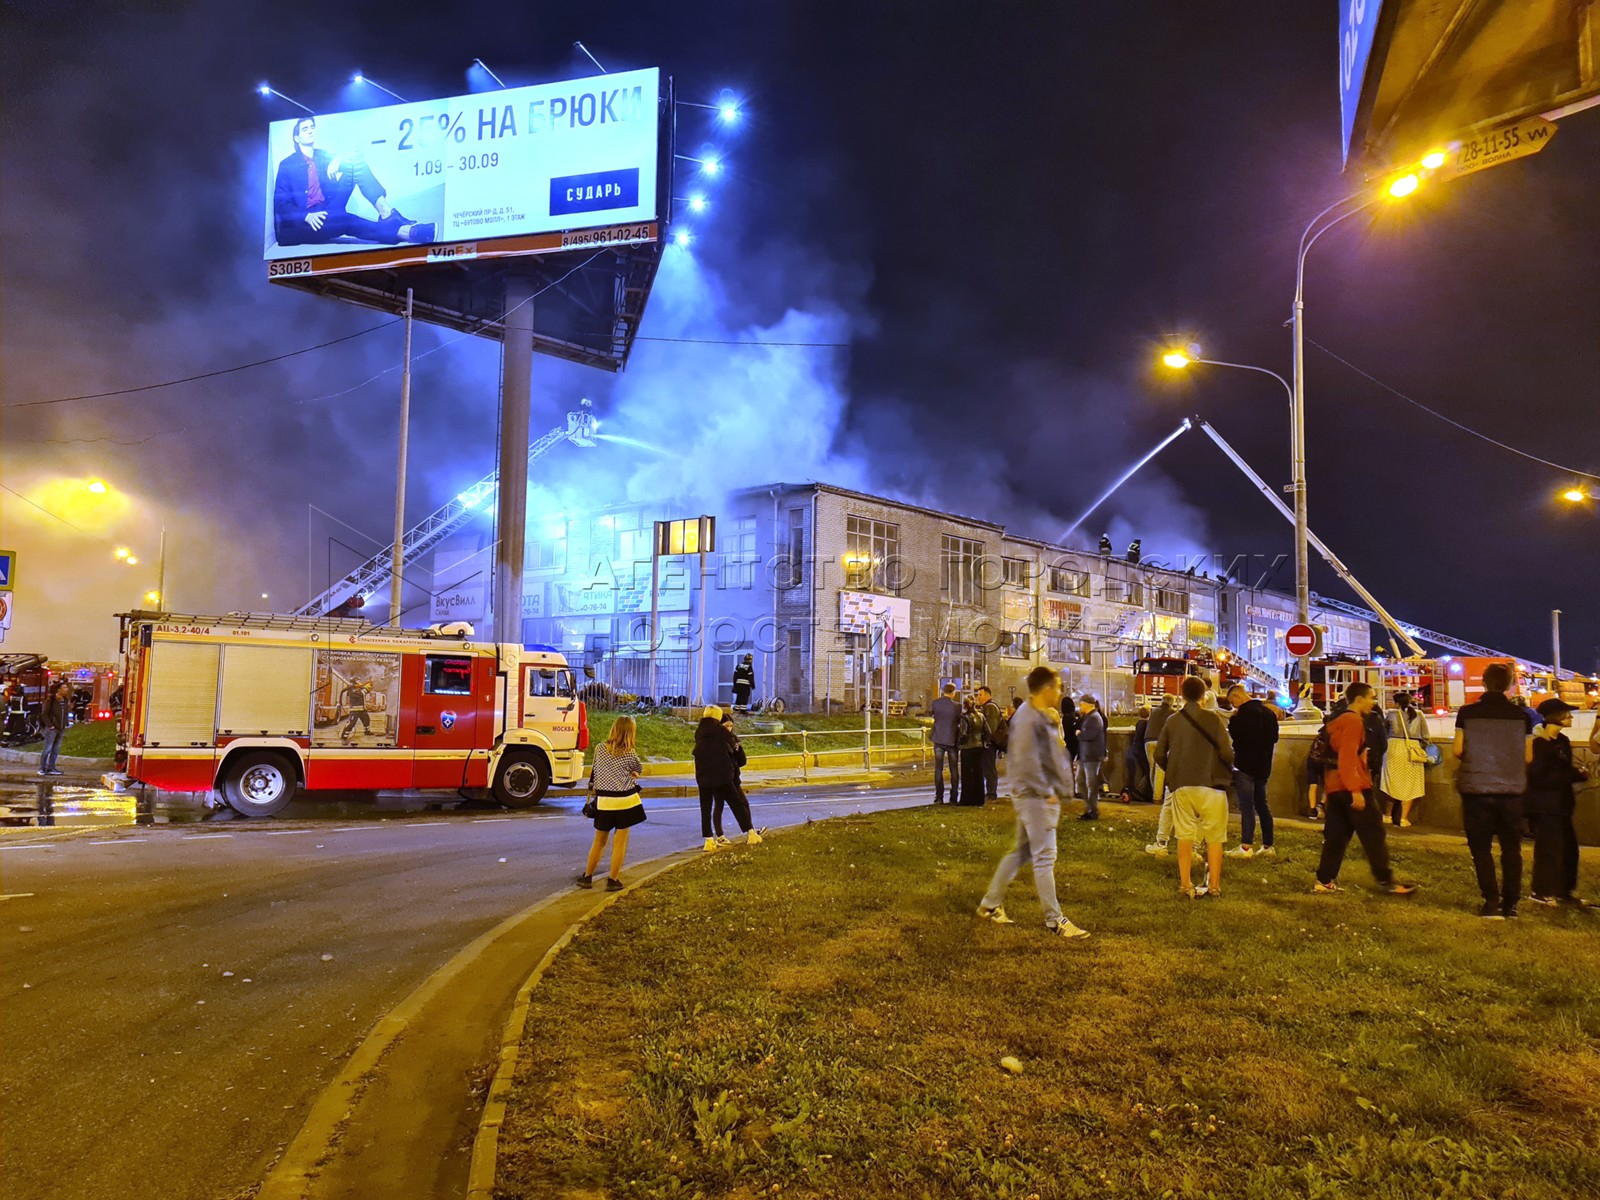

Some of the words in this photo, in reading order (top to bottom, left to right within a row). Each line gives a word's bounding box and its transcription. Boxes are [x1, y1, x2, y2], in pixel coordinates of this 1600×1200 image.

[478, 105, 517, 141] НА
[528, 85, 642, 134] БРЮКИ
[413, 159, 443, 176] 1.09
[459, 152, 499, 171] 30.09
[566, 182, 622, 202] СУДАРЬ
[269, 261, 311, 276] S30B2
[156, 625, 210, 635] АЦ-3,2-40/4
[562, 711, 568, 722] 7
